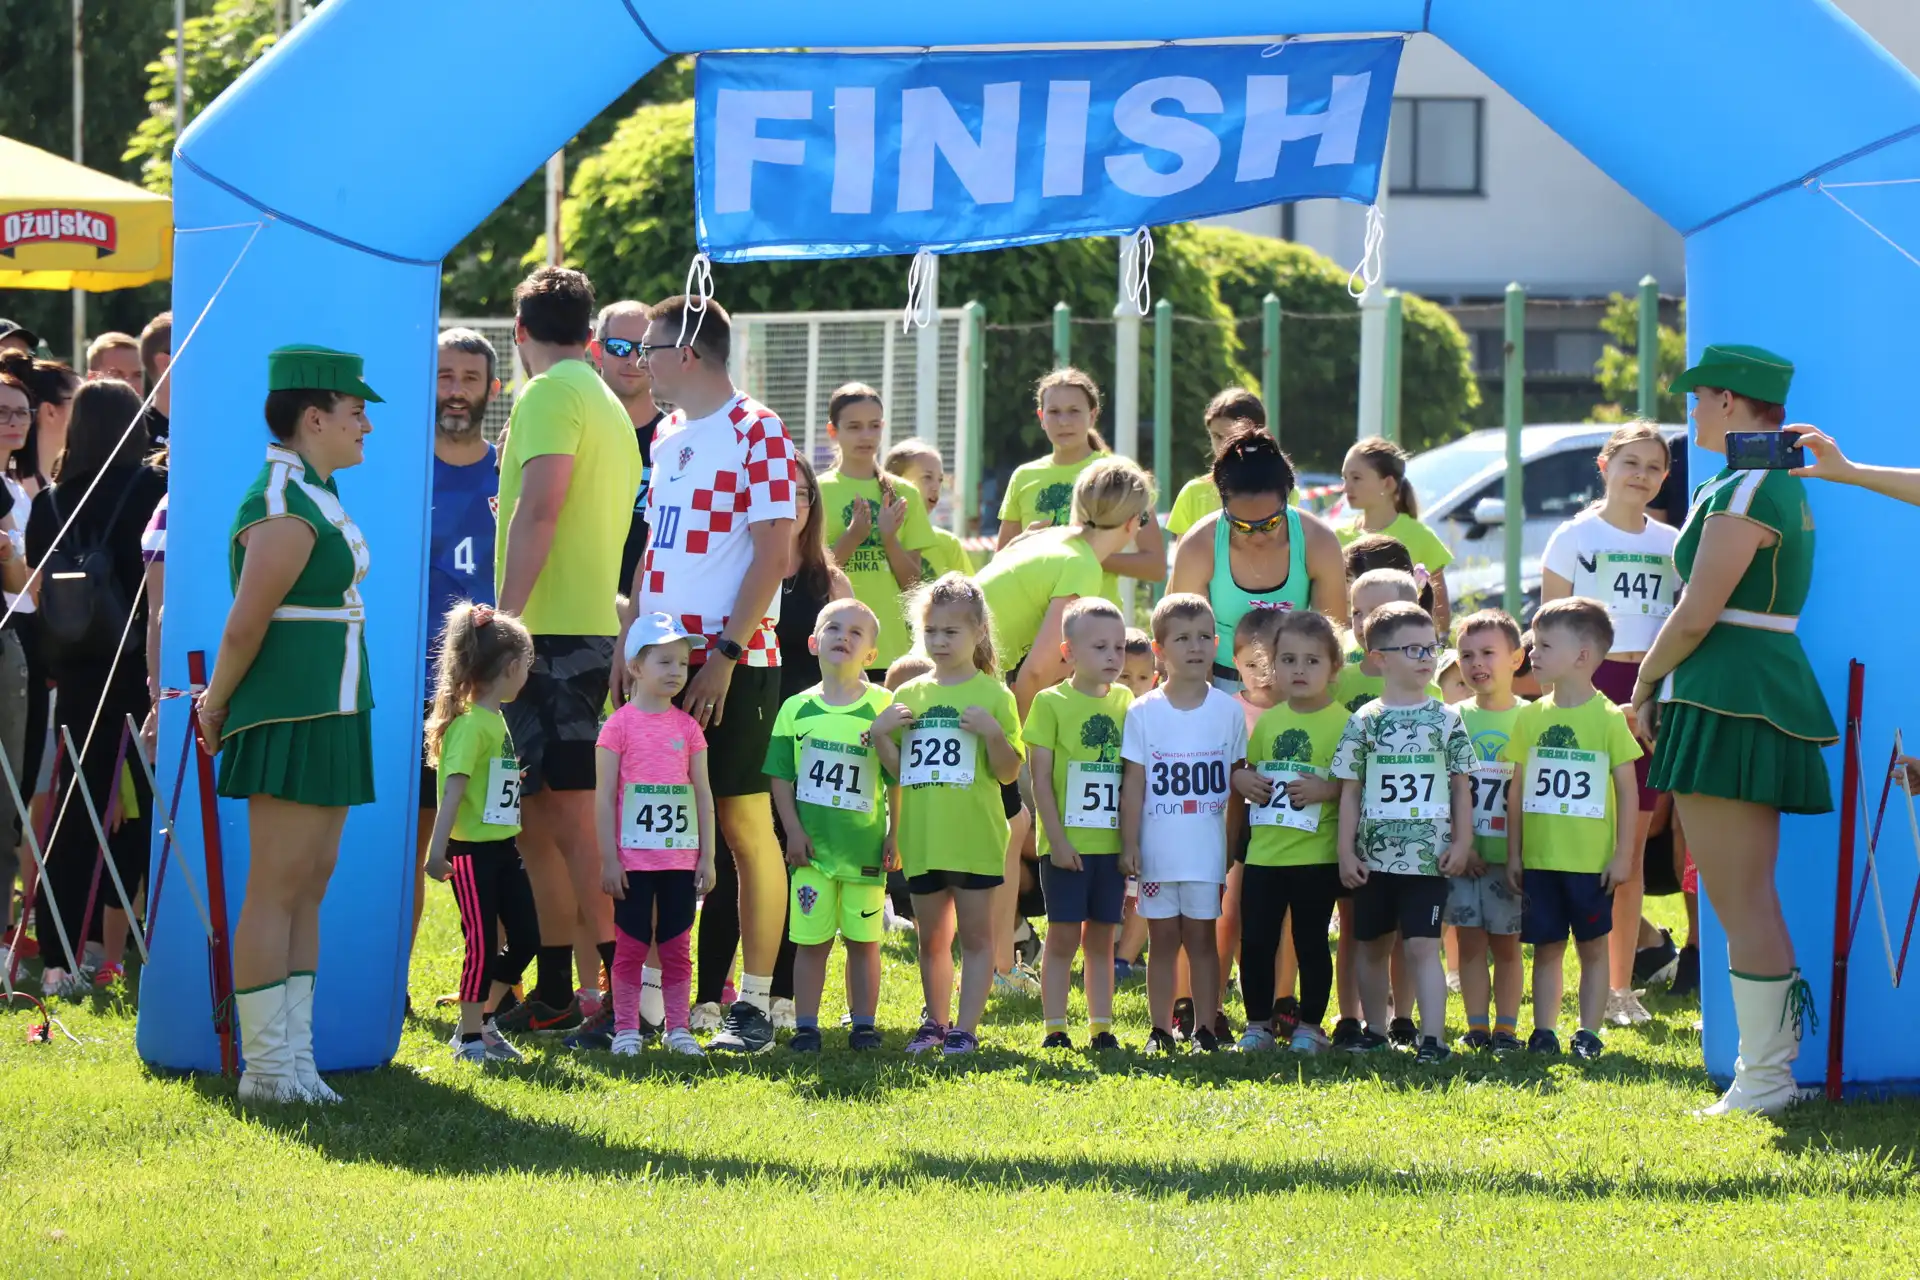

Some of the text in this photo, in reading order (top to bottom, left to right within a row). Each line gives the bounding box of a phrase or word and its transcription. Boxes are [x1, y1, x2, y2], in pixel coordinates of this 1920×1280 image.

[714, 70, 1372, 214] FINISH
[4, 209, 107, 243] Ožujsko
[653, 505, 681, 549] 10
[454, 537, 476, 575] 4
[1613, 572, 1662, 600] 447
[909, 737, 961, 768] 528
[809, 759, 862, 794] 441
[1152, 760, 1227, 797] 3800
[1380, 773, 1435, 802] 537
[1534, 768, 1592, 800] 503
[1082, 782, 1122, 813] 51
[1155, 803, 1184, 816] run
[635, 804, 689, 833] 435
